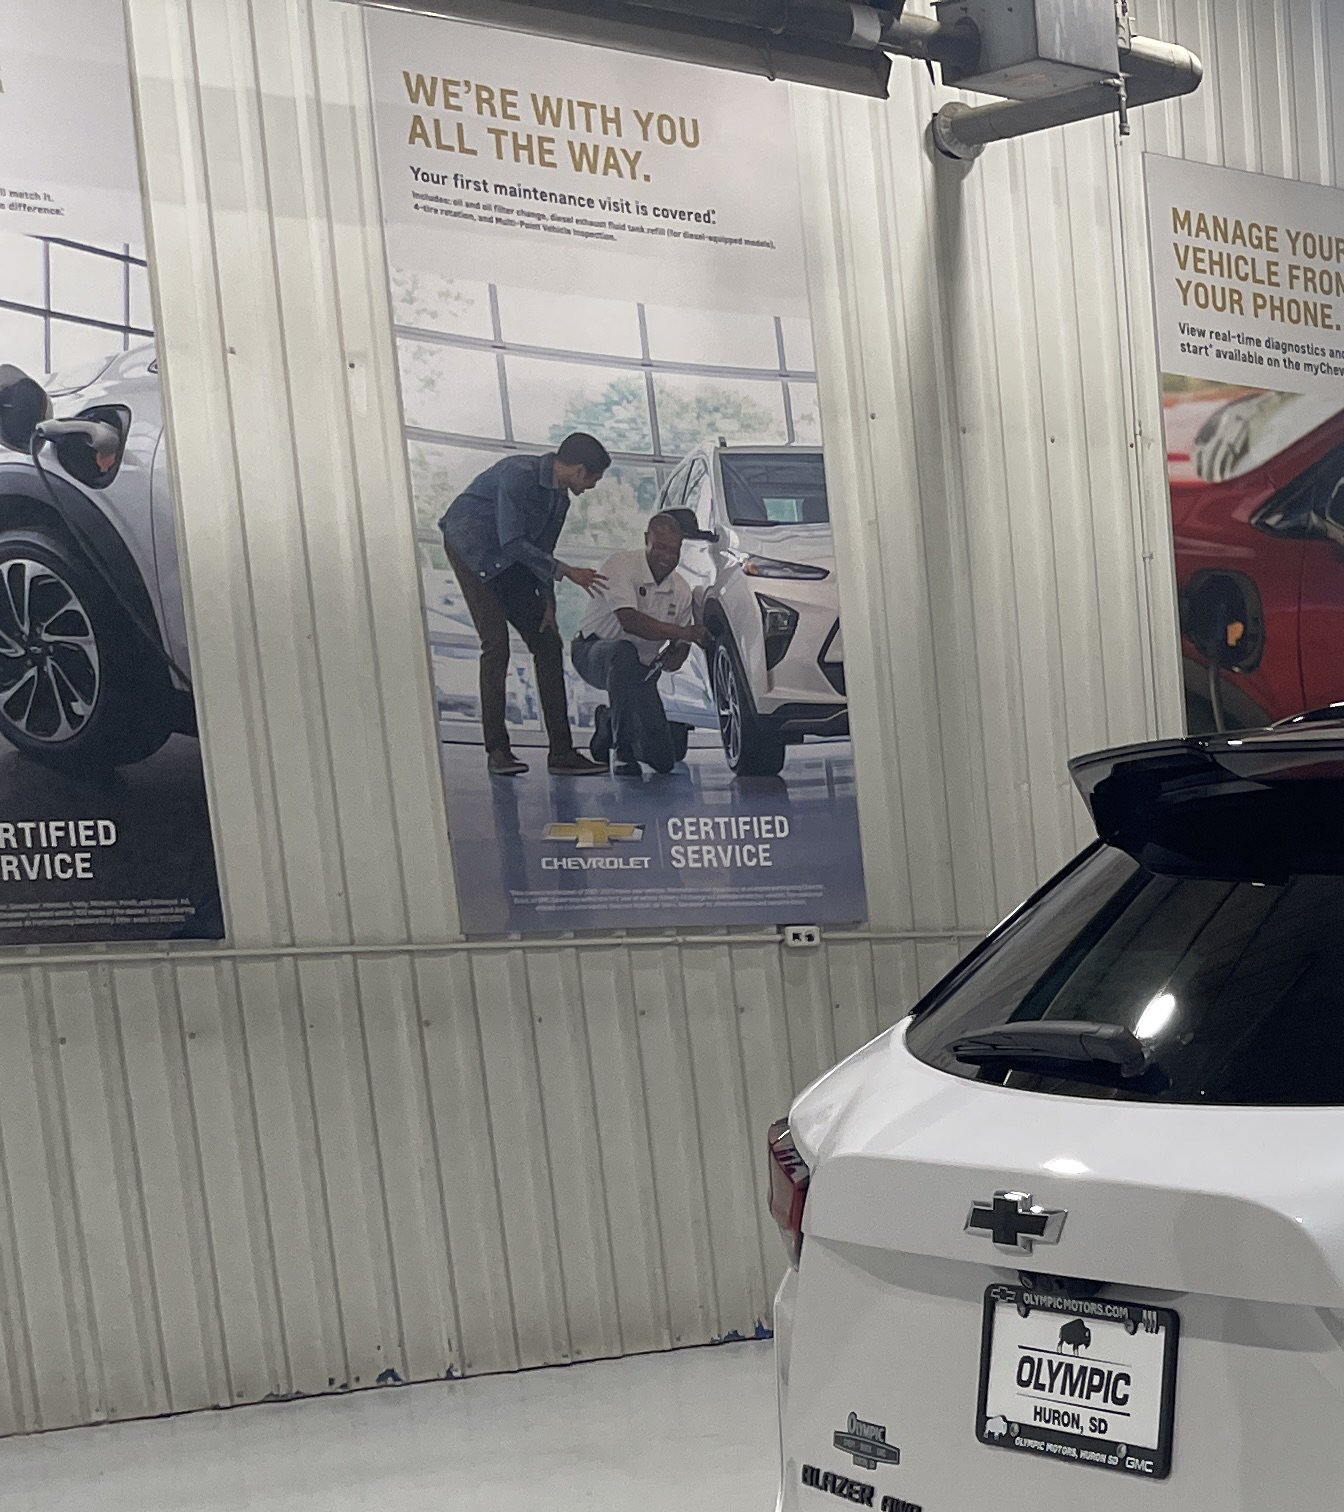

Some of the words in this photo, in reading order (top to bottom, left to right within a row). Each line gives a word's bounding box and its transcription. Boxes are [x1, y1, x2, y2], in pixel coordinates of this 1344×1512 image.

[403, 71, 520, 122] WE'RE
[530, 93, 622, 138] WITH
[633, 110, 700, 148] YOU
[408, 114, 478, 156] ALL
[487, 127, 557, 168] THE
[567, 140, 652, 182] WAY.
[410, 166, 448, 186] Your
[453, 174, 489, 194] first
[494, 183, 595, 209] maintenance
[599, 197, 631, 214] visit
[635, 201, 648, 216] is
[1171, 207, 1280, 253] MANAGE
[1172, 242, 1280, 288] VEHICLE
[1175, 278, 1245, 316] YOUR
[1252, 293, 1341, 331] PHONE.
[1178, 322, 1206, 338] View
[1209, 328, 1262, 349] real-time
[1264, 336, 1326, 357] diagnostics
[1215, 348, 1264, 366] available
[1267, 357, 1281, 367] on
[1283, 357, 1300, 371] the
[667, 815, 790, 841] CERTIFIED
[541, 856, 651, 870] CHEVROLET
[670, 844, 773, 869] SERVICE
[1016, 1355, 1131, 1407] OLYMPIC
[1033, 1405, 1085, 1435] HURON,
[1089, 1416, 1109, 1435] SD
[1015, 1436, 1045, 1451] OLYMPIC
[1079, 1450, 1106, 1464] HURON
[1107, 1455, 1119, 1466] SD
[1125, 1456, 1154, 1473] GMC
[801, 1464, 875, 1508] BLAZER
